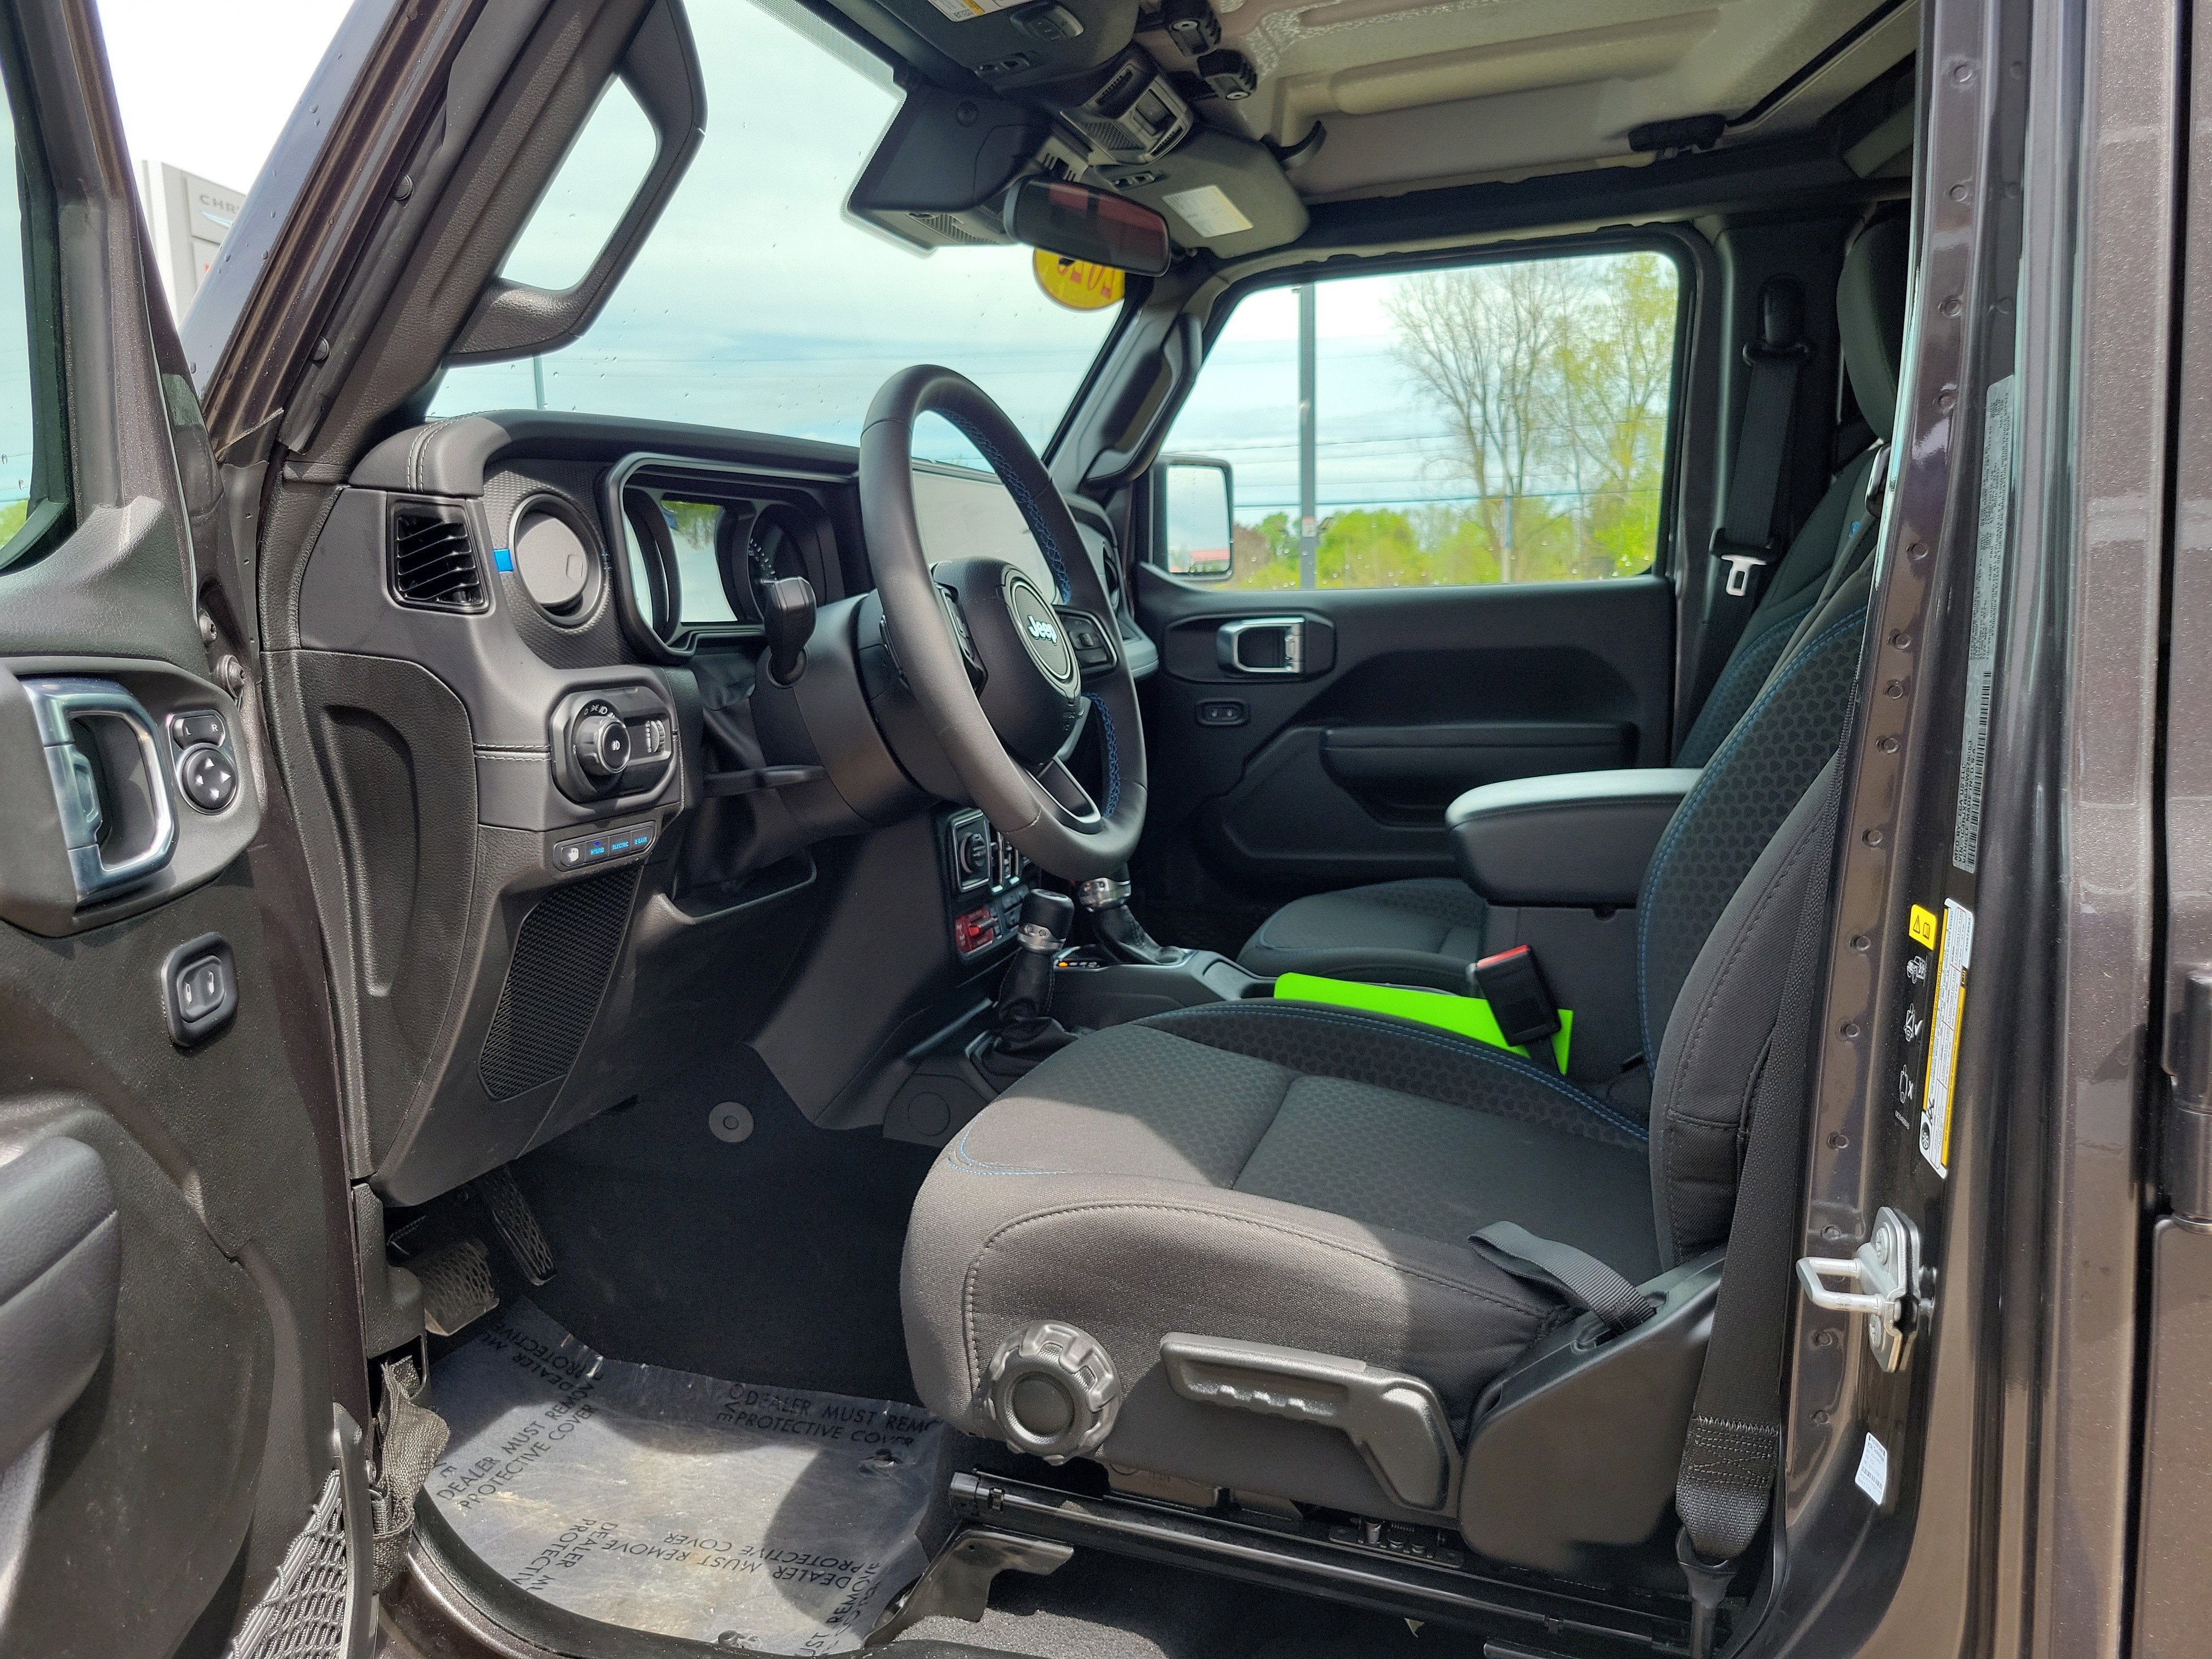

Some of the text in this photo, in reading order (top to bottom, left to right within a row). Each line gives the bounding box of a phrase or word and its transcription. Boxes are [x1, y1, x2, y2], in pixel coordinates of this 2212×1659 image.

[199, 195, 239, 211] CHR
[1028, 615, 1057, 645] Jeep
[185, 727, 191, 735] L
[211, 724, 219, 732] R
[744, 1390, 814, 1415] DEALER
[822, 1404, 876, 1424] MUST
[736, 1411, 846, 1440] PROTECTIVE
[436, 1455, 501, 1500] DEALER
[500, 1420, 546, 1455] MUST
[459, 1403, 599, 1509] PROTECTIVE COVER
[556, 1521, 619, 1568] DEALER
[663, 1532, 866, 1574] PROTECTIVE COVER
[601, 1539, 853, 1589] DEALER MUST REMOVE
